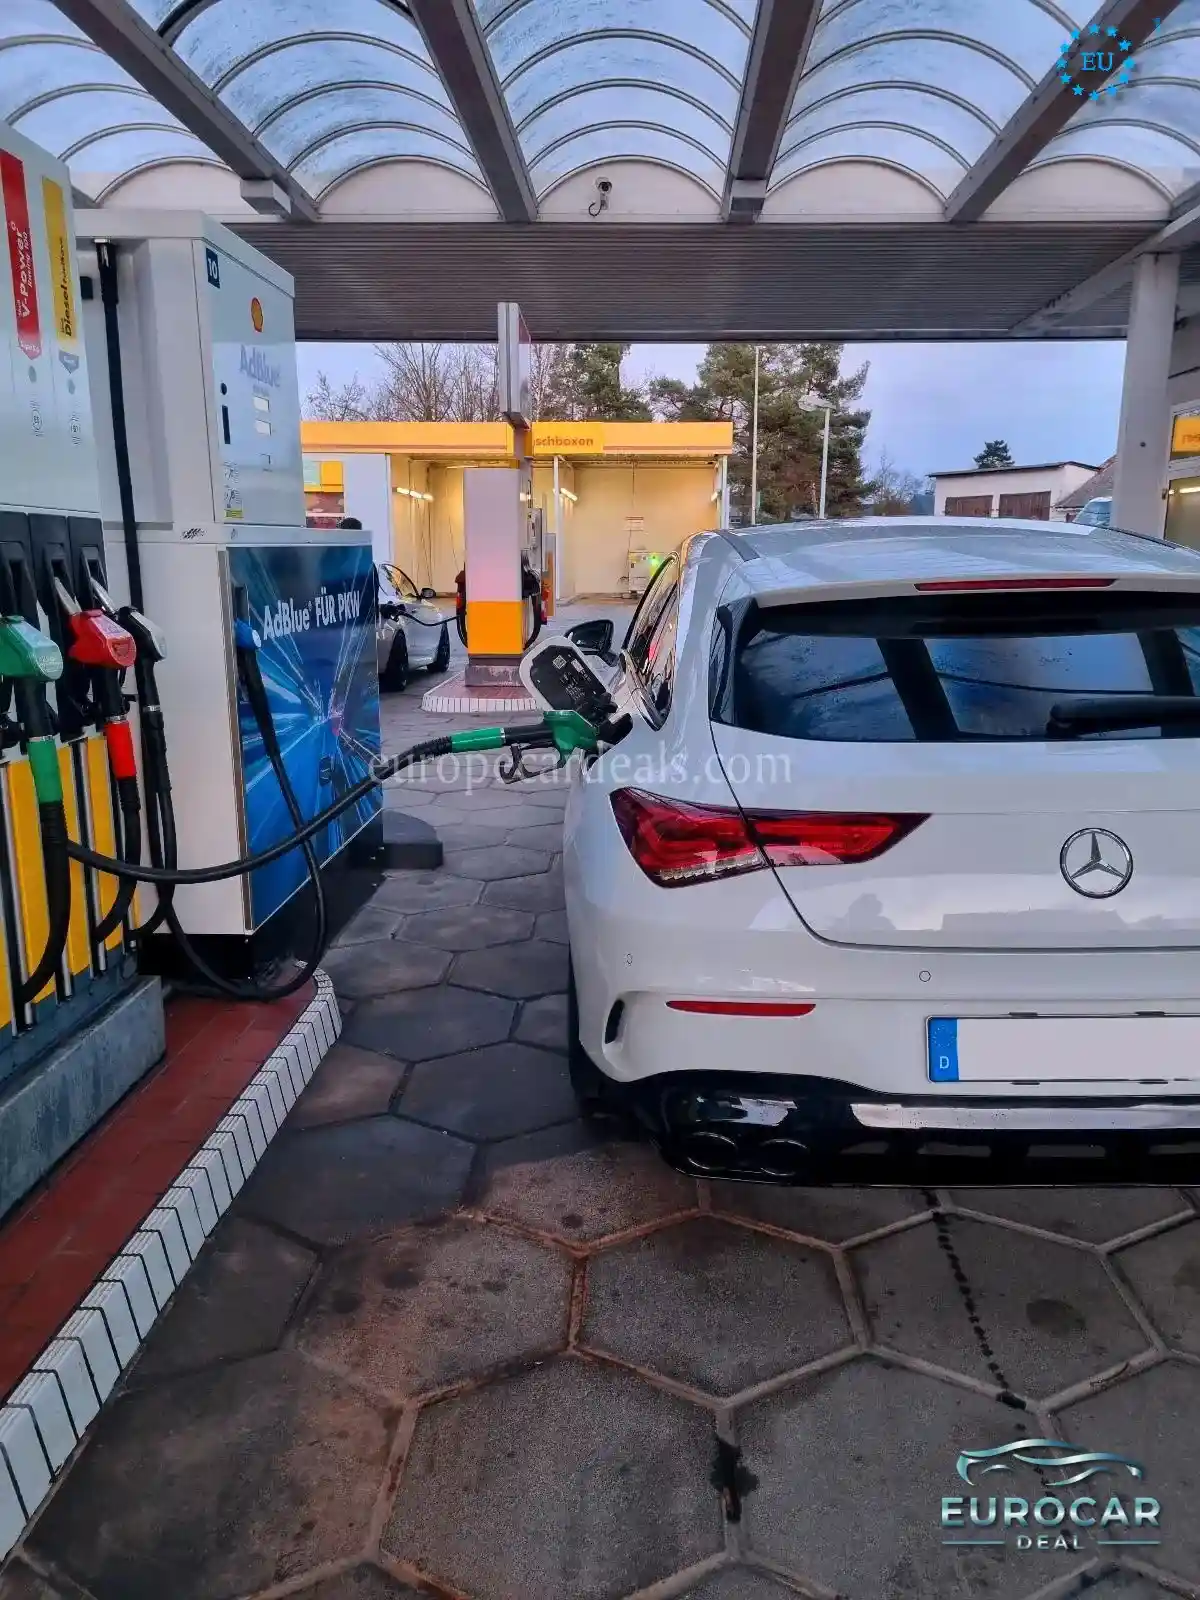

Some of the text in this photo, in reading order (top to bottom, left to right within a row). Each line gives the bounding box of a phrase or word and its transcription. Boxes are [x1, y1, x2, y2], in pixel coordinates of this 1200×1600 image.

[207, 258, 218, 280] 10
[60, 284, 73, 337] Diesel
[314, 586, 337, 628] FÜR
[337, 590, 361, 621] PKW
[939, 1055, 950, 1069] D
